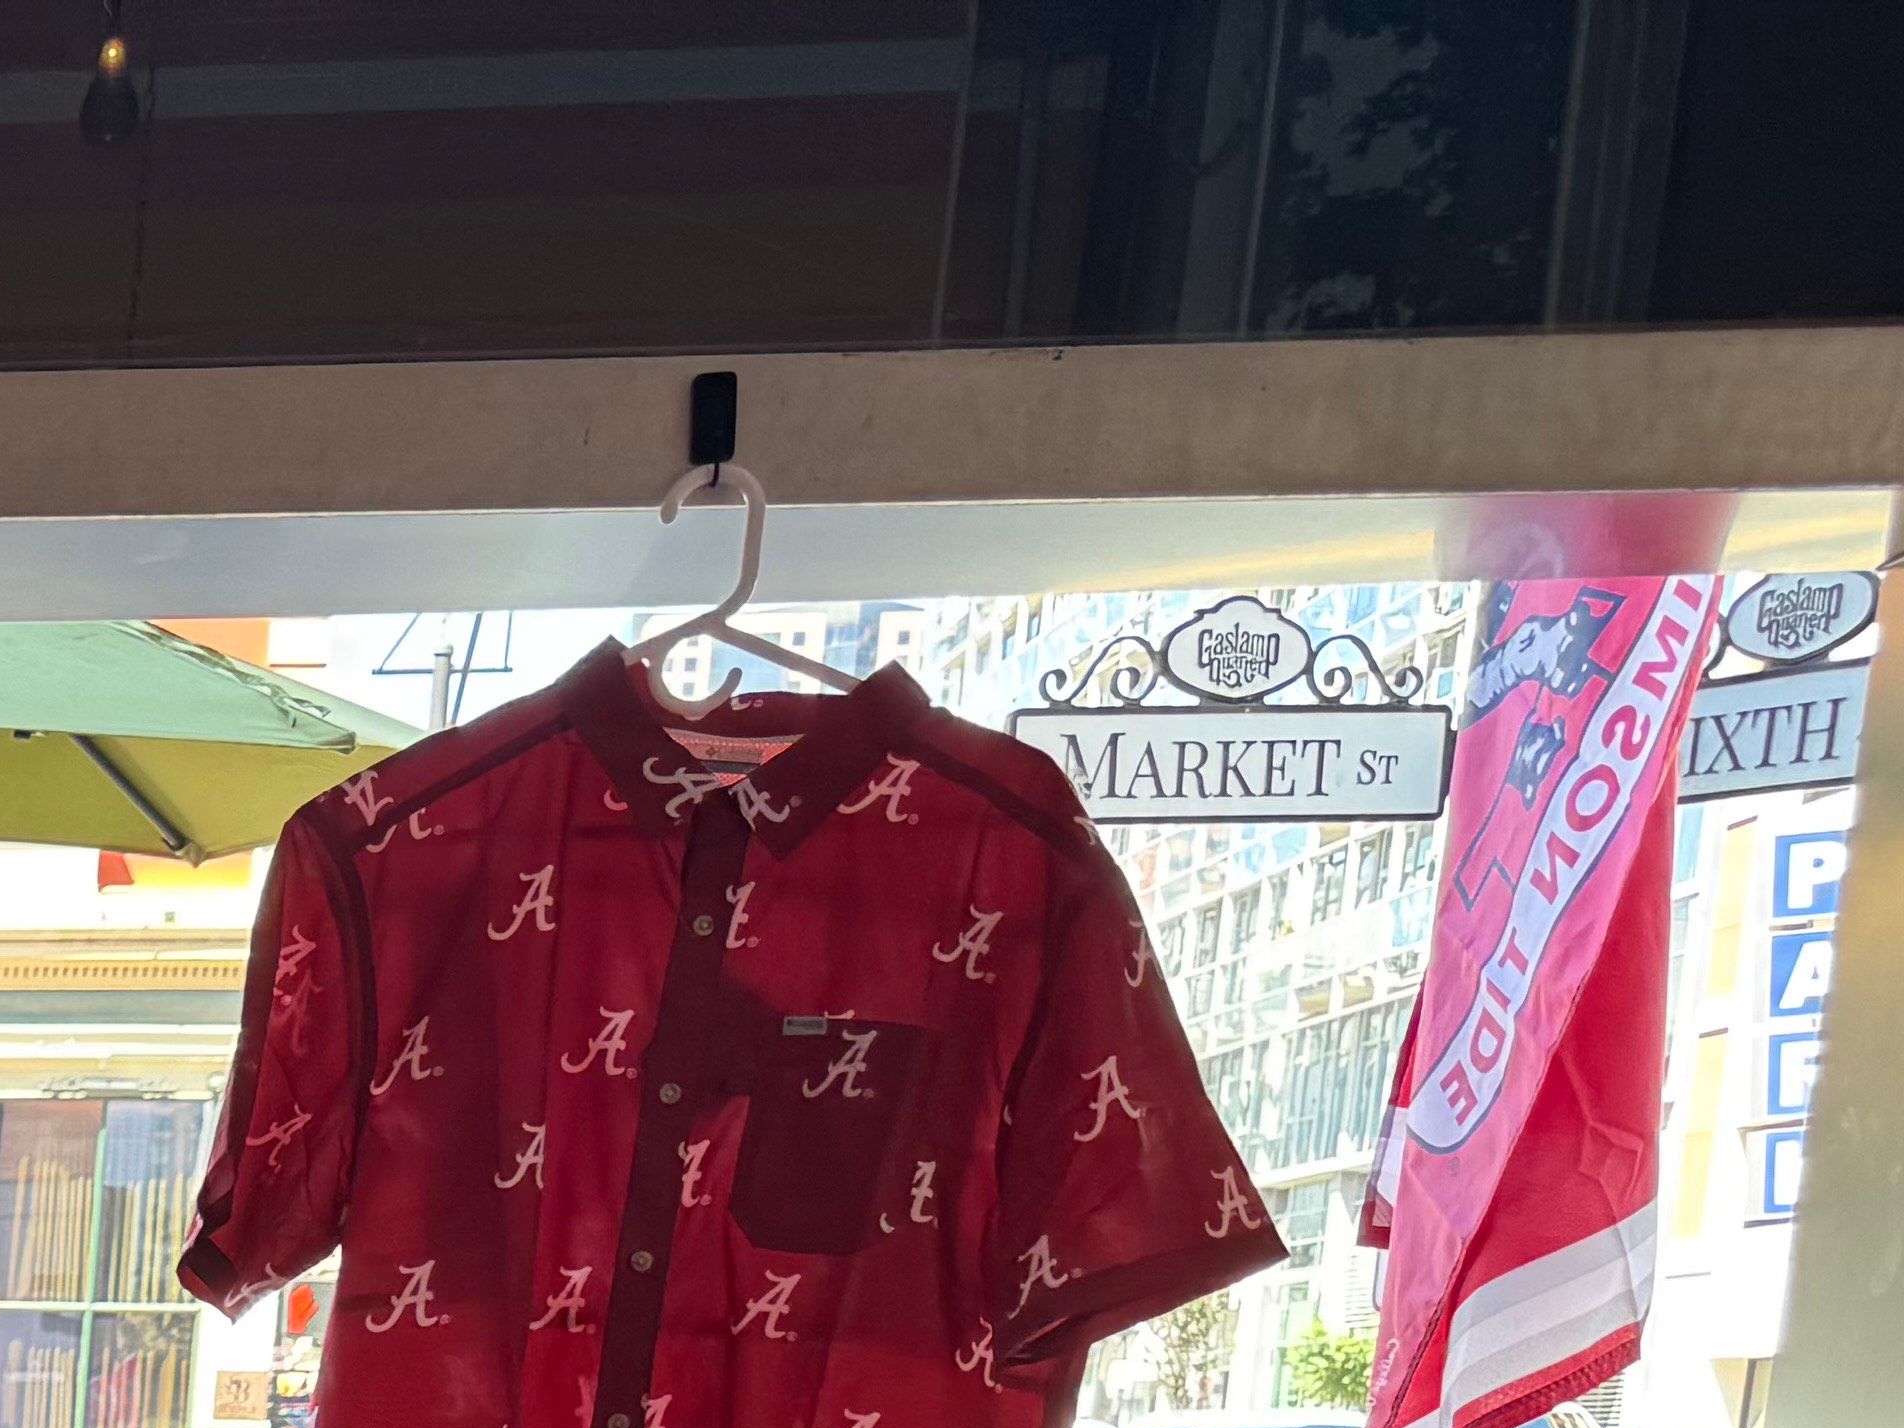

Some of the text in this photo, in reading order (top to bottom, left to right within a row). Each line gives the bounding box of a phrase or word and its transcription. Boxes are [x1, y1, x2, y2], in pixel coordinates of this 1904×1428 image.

[1198, 622, 1281, 669] Gaslamp
[1059, 731, 1400, 800] MARKET ST
[1682, 696, 1848, 778] IXTH
